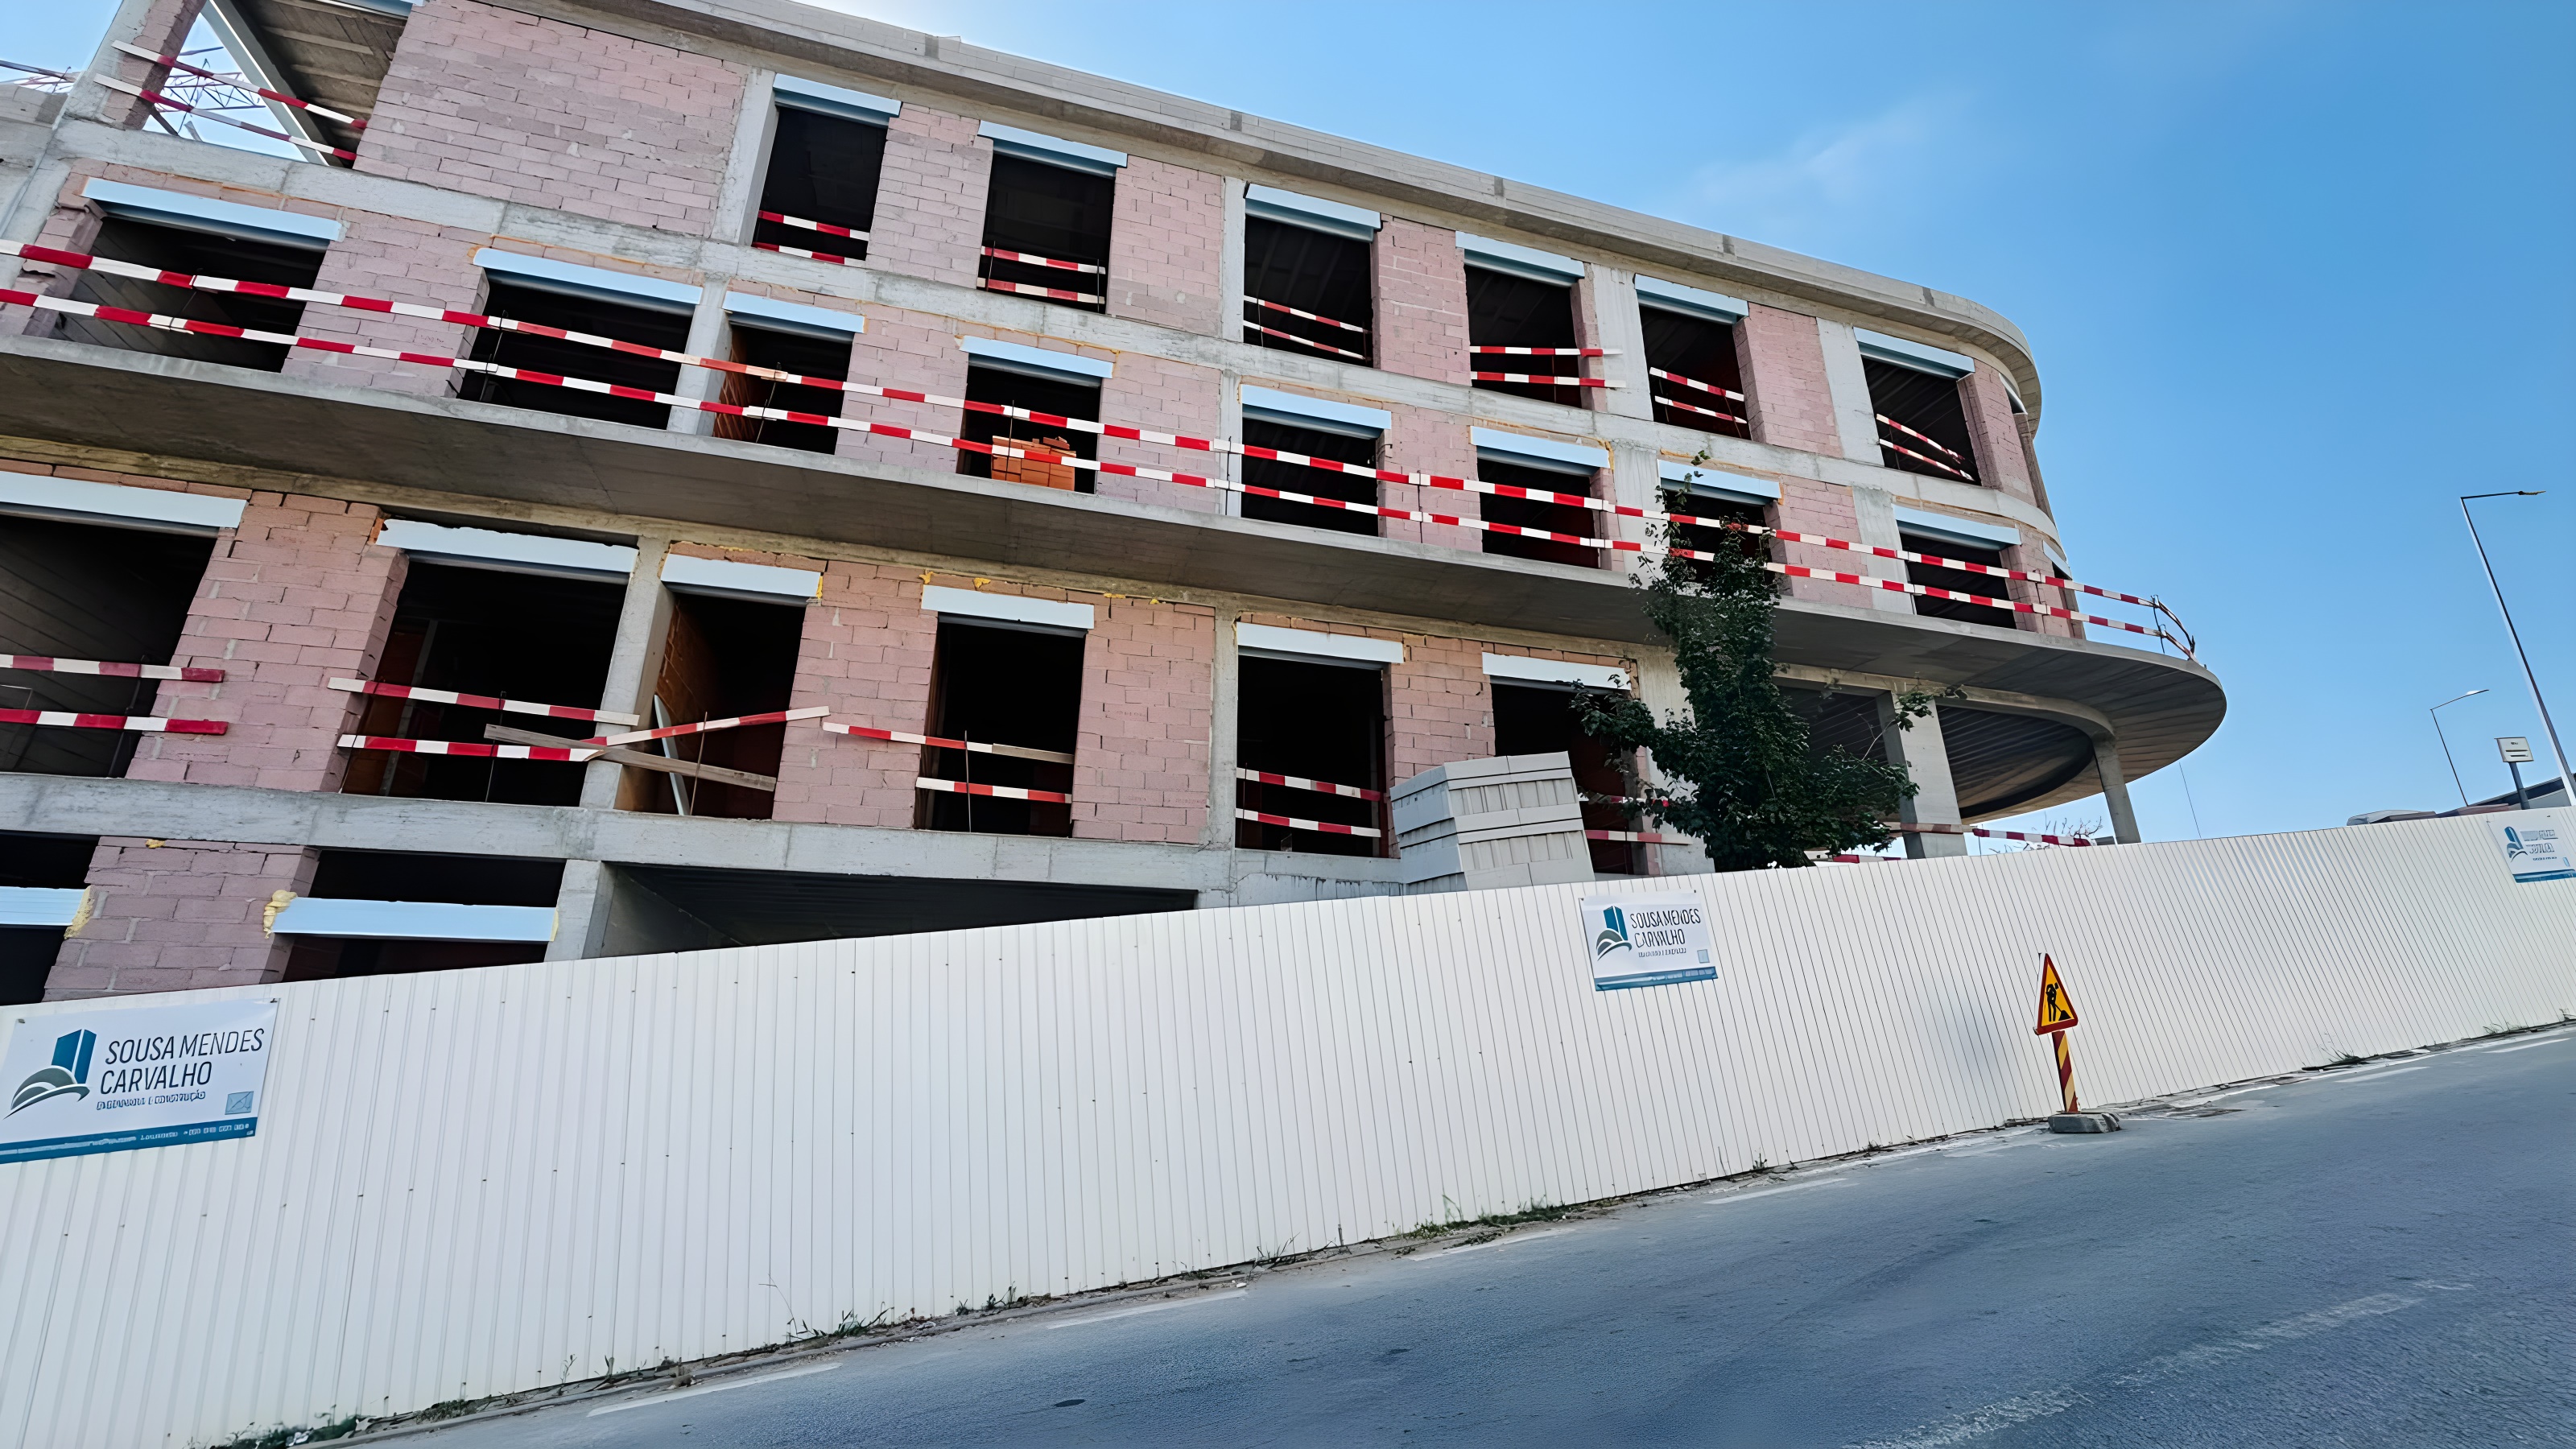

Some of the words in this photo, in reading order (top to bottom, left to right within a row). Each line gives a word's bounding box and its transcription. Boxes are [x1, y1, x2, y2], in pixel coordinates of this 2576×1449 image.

[1630, 911, 1663, 929] SOUSA
[105, 1035, 175, 1065] SOUSA
[179, 1029, 265, 1059] MENDES
[101, 1061, 213, 1095] CARVALHO
